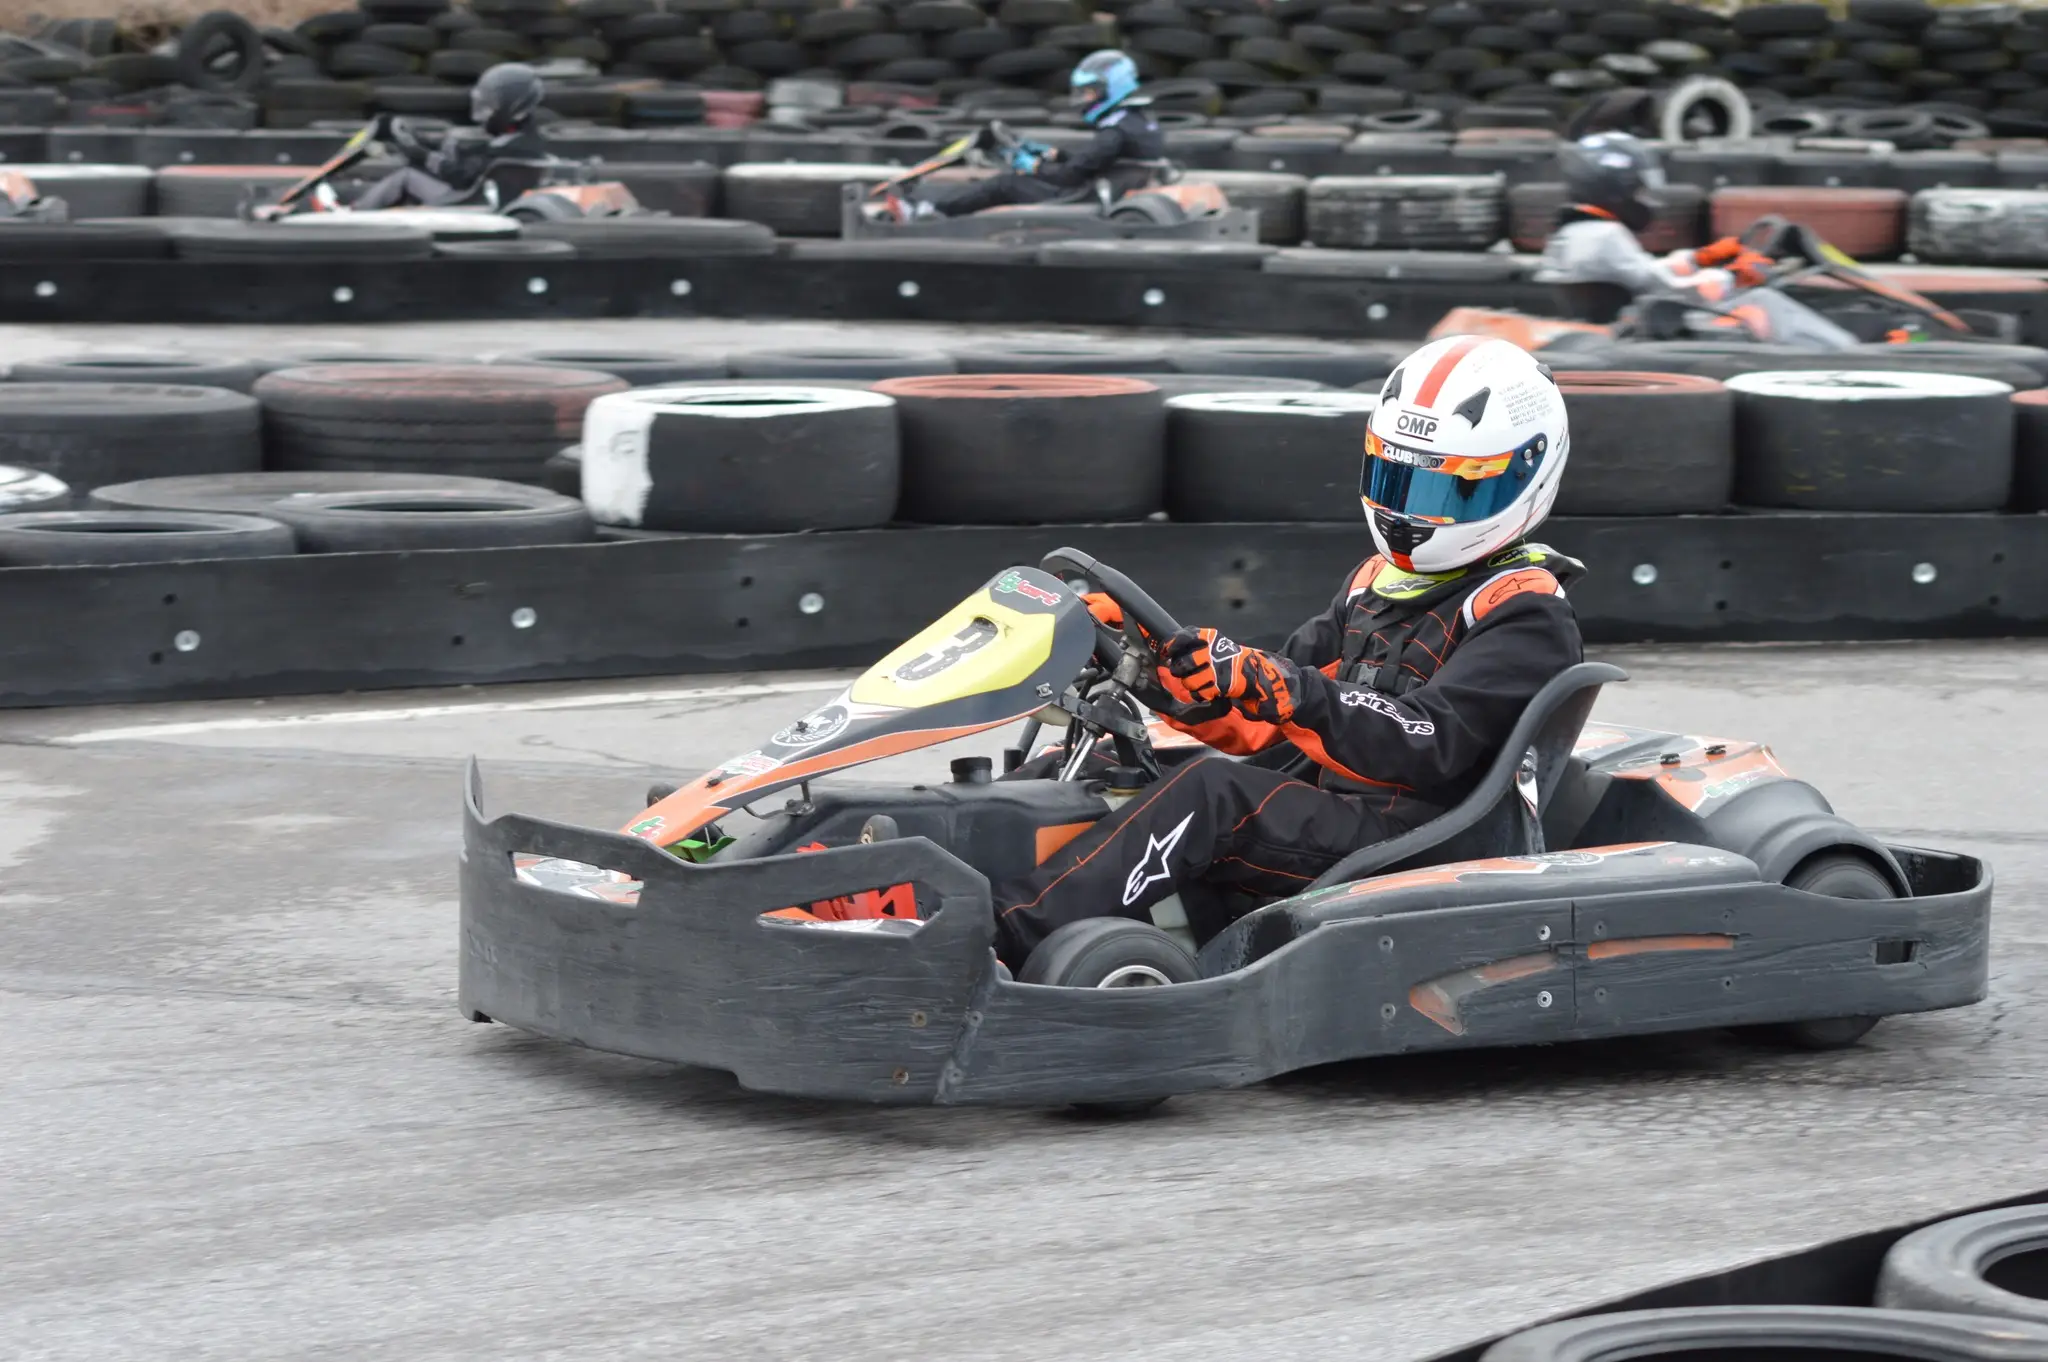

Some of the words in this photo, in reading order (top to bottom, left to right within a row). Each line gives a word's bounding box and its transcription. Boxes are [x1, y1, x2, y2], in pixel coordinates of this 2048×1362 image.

[1397, 415, 1438, 436] OMP
[1383, 444, 1441, 469] CLUB100
[895, 616, 999, 682] 3
